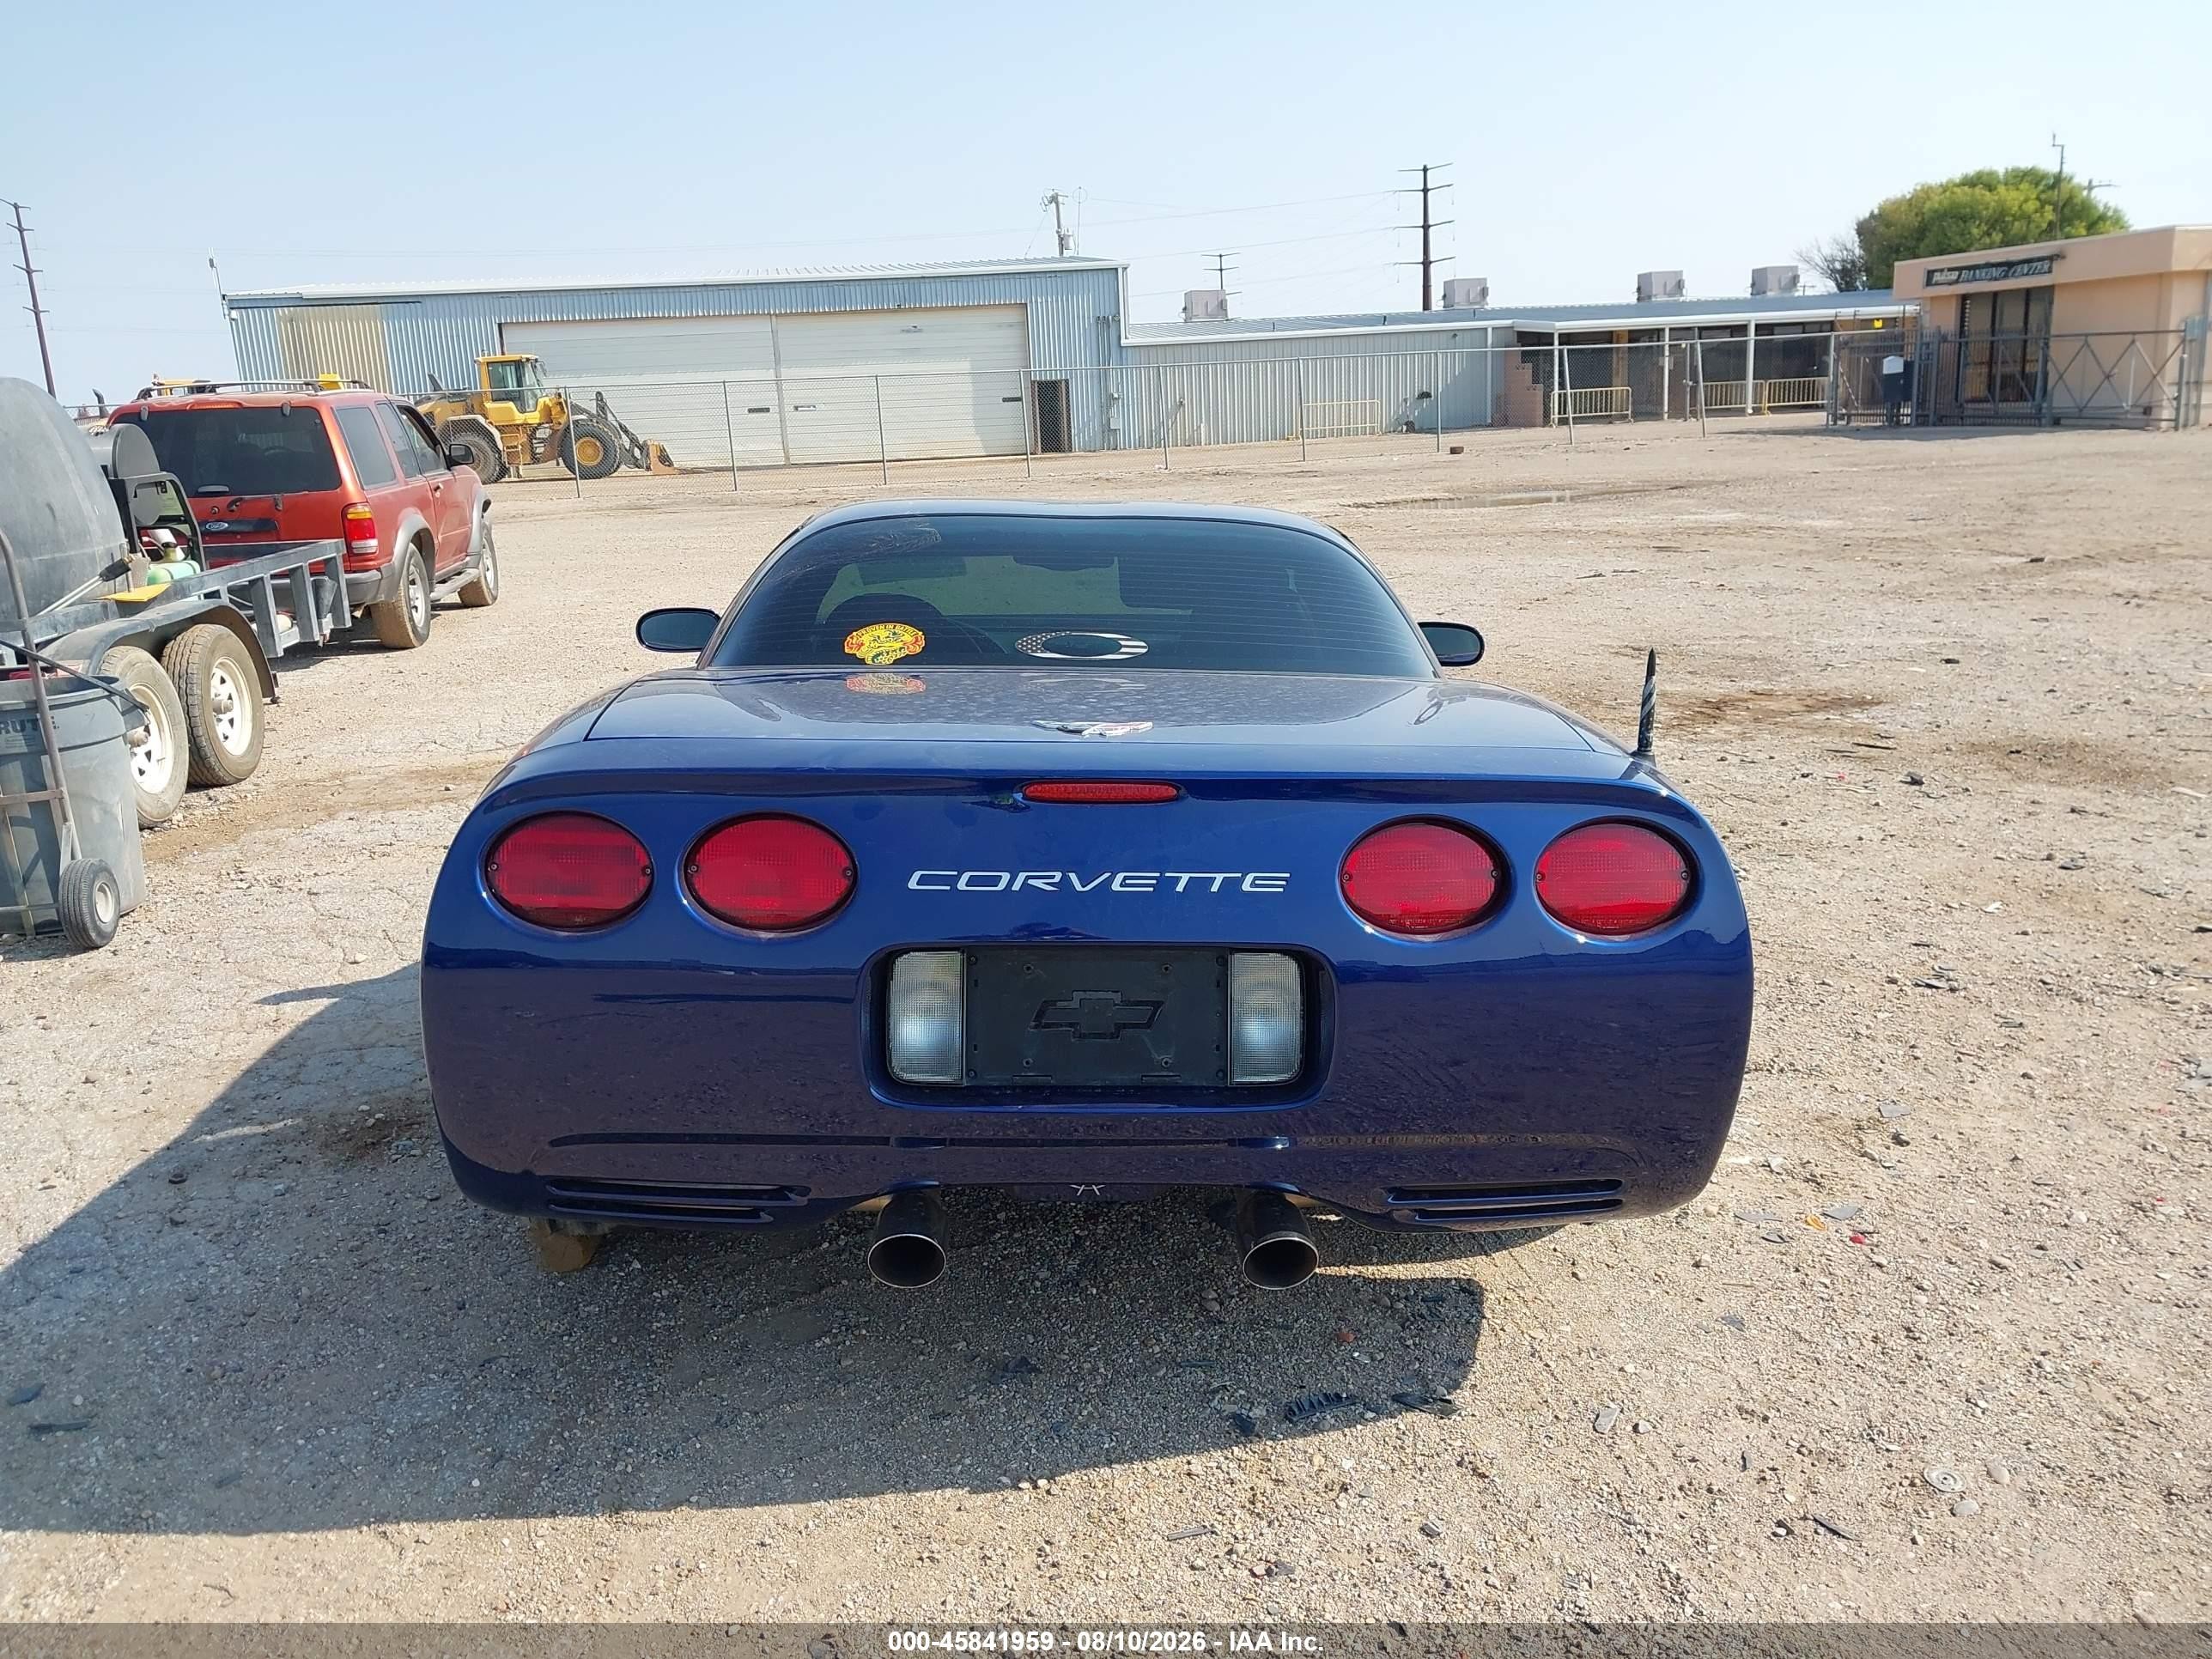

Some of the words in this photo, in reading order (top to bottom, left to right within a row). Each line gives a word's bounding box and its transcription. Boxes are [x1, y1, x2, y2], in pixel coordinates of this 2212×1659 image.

[1959, 266, 2008, 283] BANKING
[2008, 260, 2051, 277] CENTER
[856, 624, 885, 638] PROVEN
[895, 624, 917, 636] BATTLE
[906, 870, 1291, 892] CORVETTE
